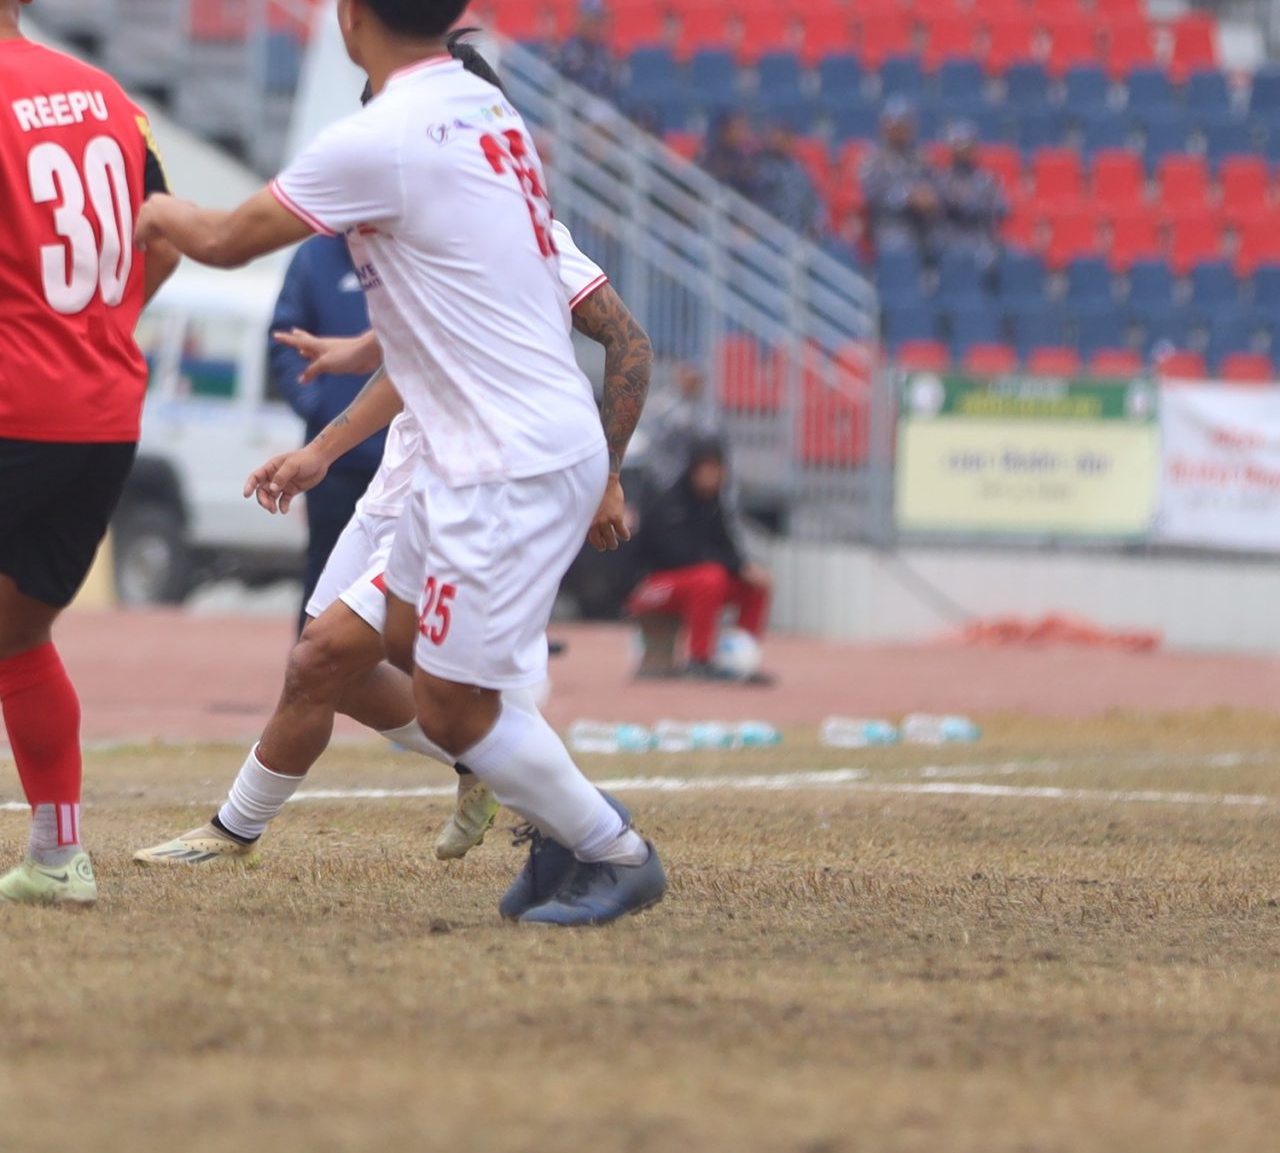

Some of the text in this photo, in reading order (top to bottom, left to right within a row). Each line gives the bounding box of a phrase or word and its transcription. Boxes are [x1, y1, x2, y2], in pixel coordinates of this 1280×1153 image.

[12, 90, 109, 132] REEPU
[27, 135, 133, 314] 30
[418, 576, 457, 647] 25
